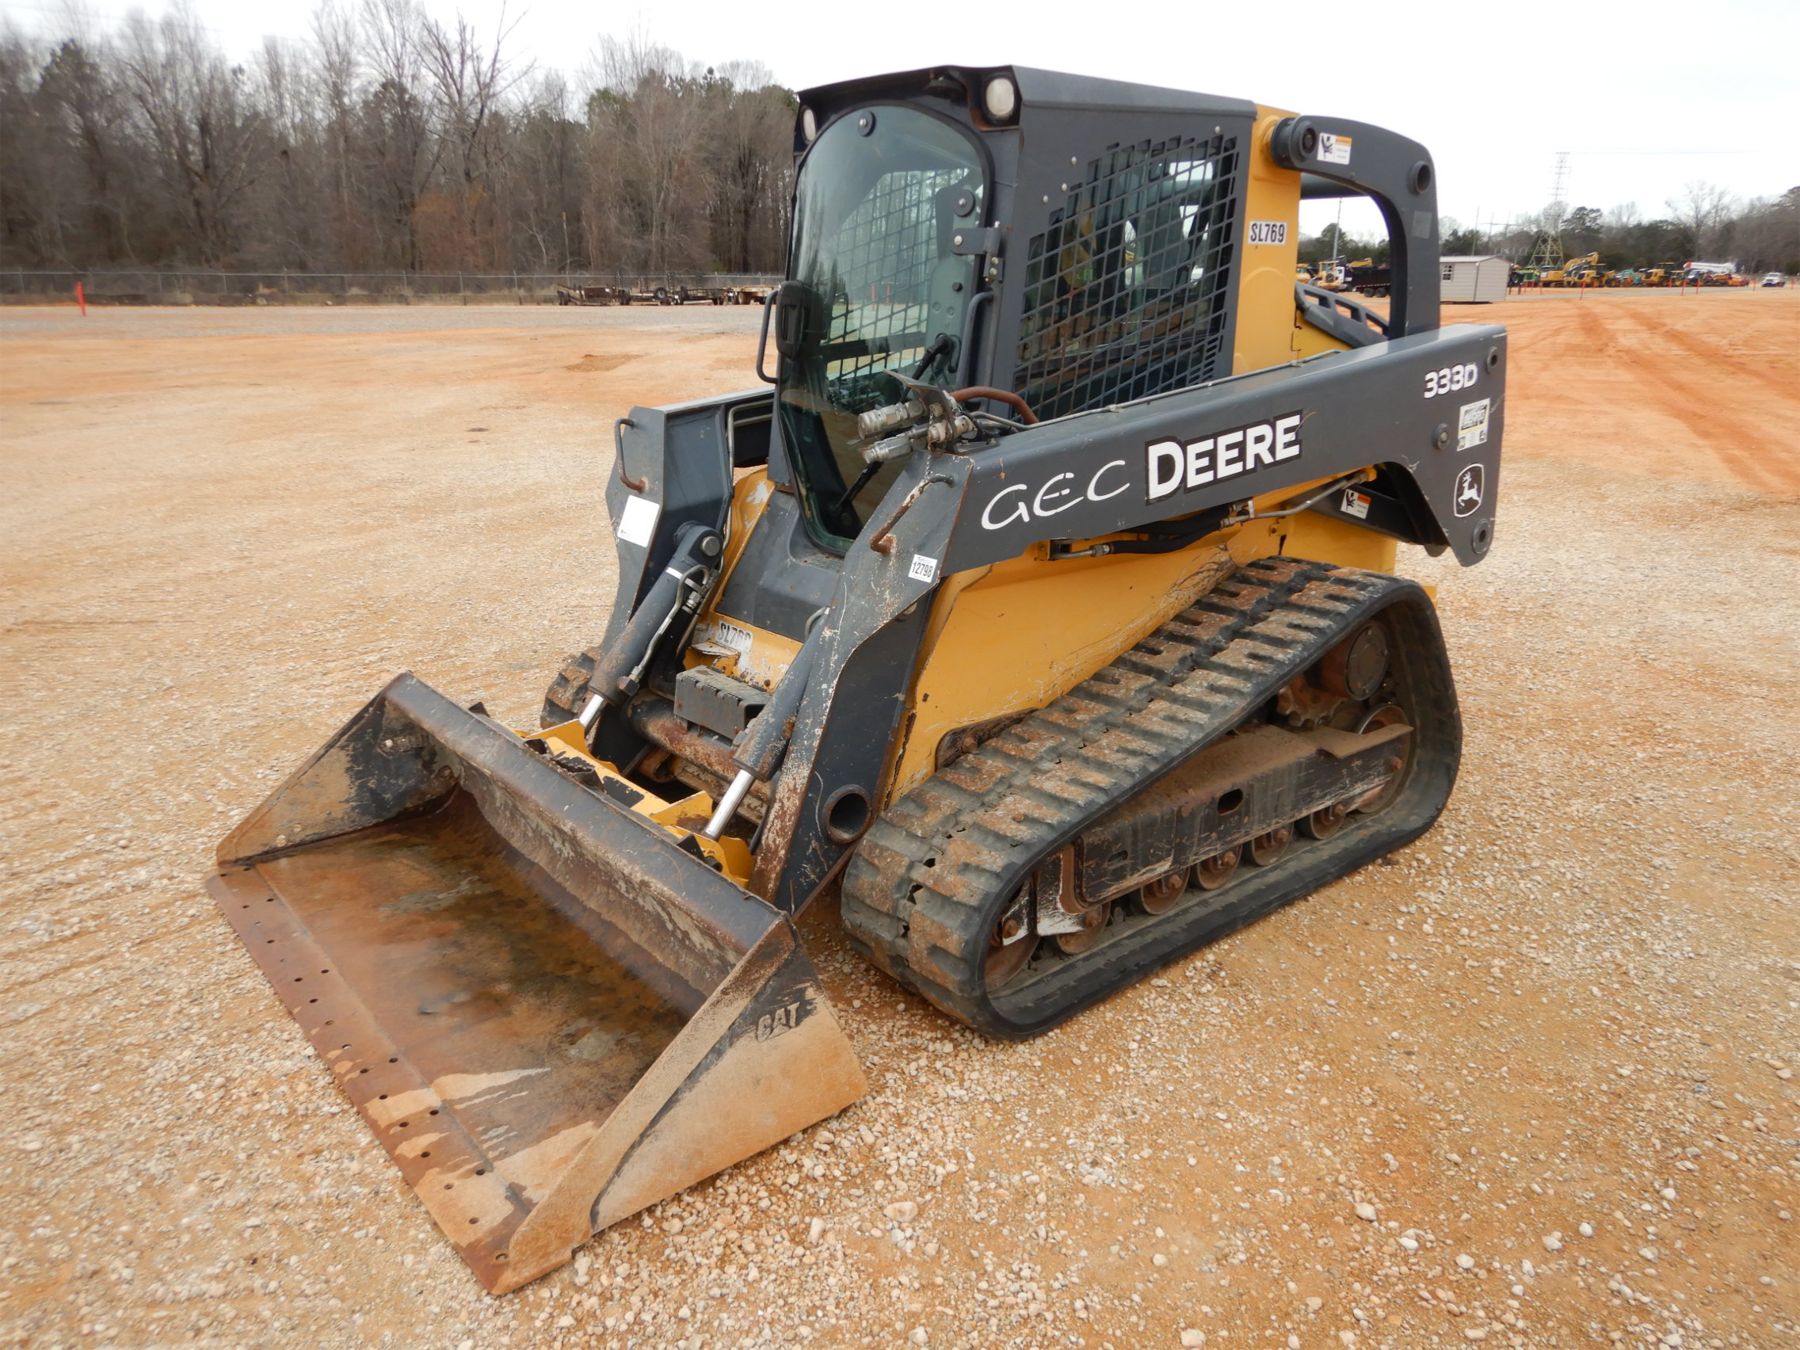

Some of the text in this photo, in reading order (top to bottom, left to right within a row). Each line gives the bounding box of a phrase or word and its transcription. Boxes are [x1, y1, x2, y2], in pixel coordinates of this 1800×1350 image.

[1250, 222, 1285, 243] SL769
[1423, 364, 1478, 398] 333D
[1148, 414, 1301, 500] DEERE
[981, 459, 1131, 530] GEC
[755, 1001, 801, 1043] CAT
